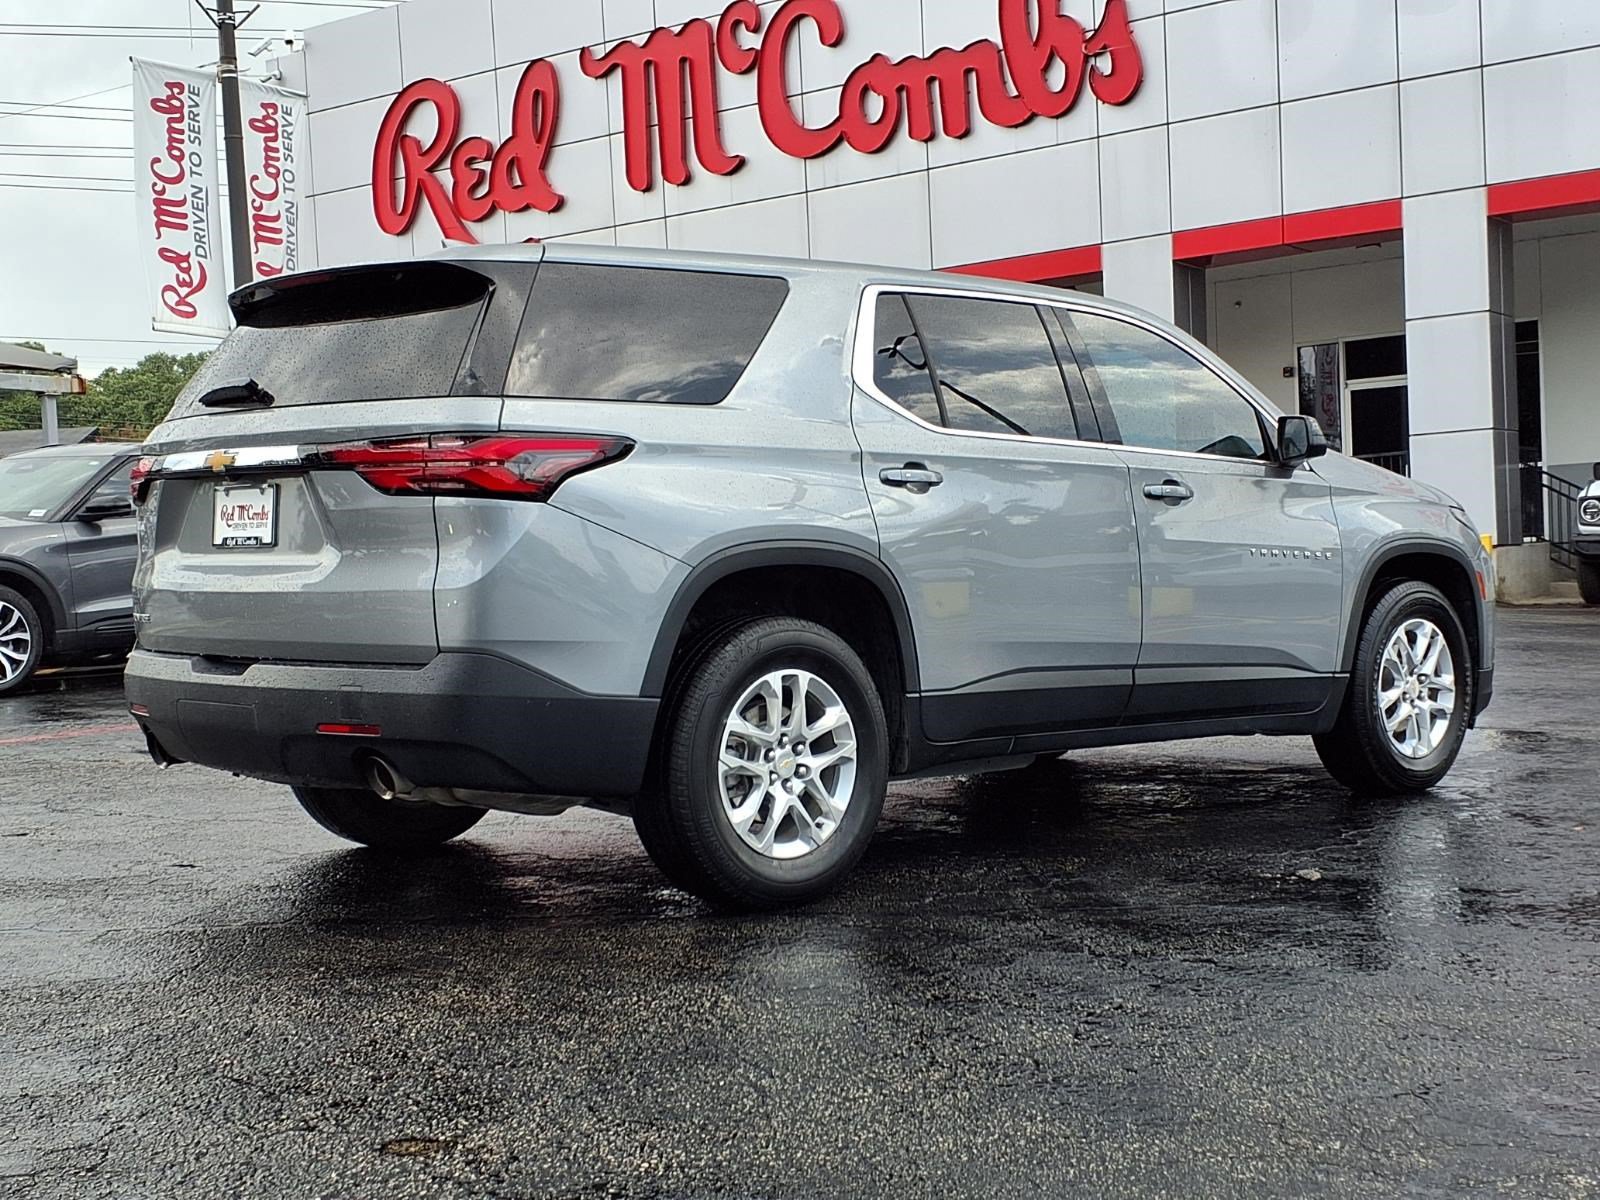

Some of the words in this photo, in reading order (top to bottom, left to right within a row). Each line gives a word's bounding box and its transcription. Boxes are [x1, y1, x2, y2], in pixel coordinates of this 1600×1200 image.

[187, 84, 202, 147] SERVE
[281, 104, 294, 164] SERVE
[372, 59, 564, 244] Red
[580, 0, 1143, 192] McCombs
[150, 81, 189, 240] McCombs
[189, 151, 204, 178] TO
[248, 101, 284, 253] McCombs
[282, 169, 296, 194] TO
[191, 185, 208, 260] DRIVEN
[285, 200, 297, 272] DRIVEN
[157, 247, 208, 319] Red
[220, 504, 235, 528] Red
[237, 504, 270, 521] McCombs
[1249, 548, 1333, 560] TRAVERSE
